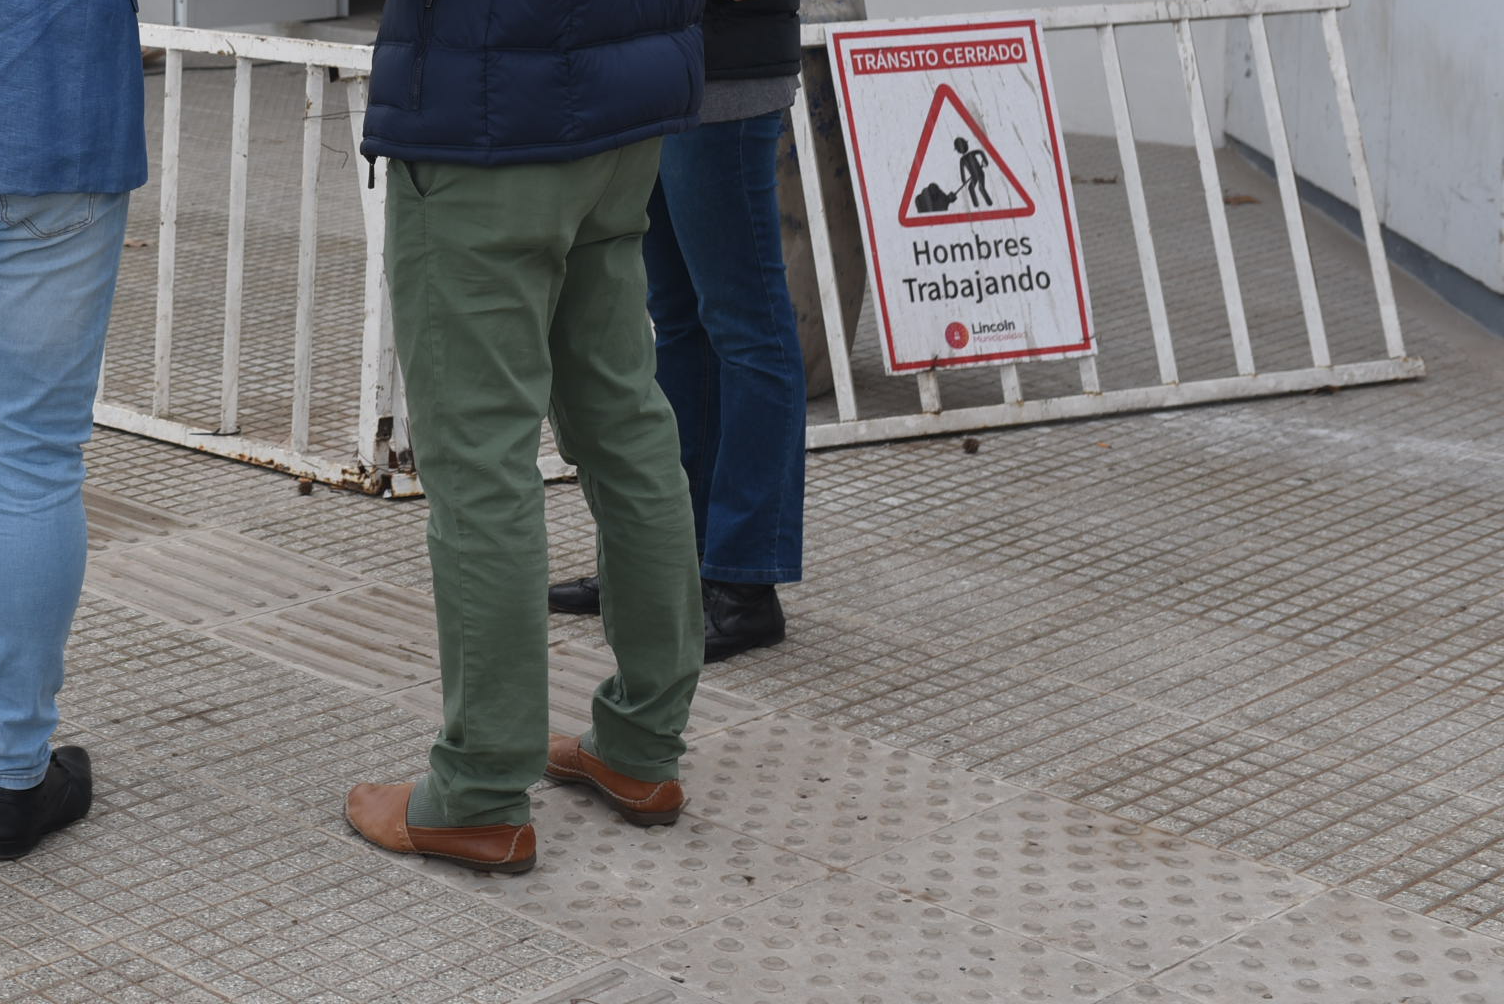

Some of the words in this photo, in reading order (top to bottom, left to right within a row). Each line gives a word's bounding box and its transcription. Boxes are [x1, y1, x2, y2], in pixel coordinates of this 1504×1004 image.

[852, 49, 939, 71] TRÁNSITO
[942, 43, 1024, 65] CERRADO
[912, 234, 1033, 266] Hombres
[902, 265, 1051, 304] Trabajando
[971, 319, 1016, 335] Lincoln
